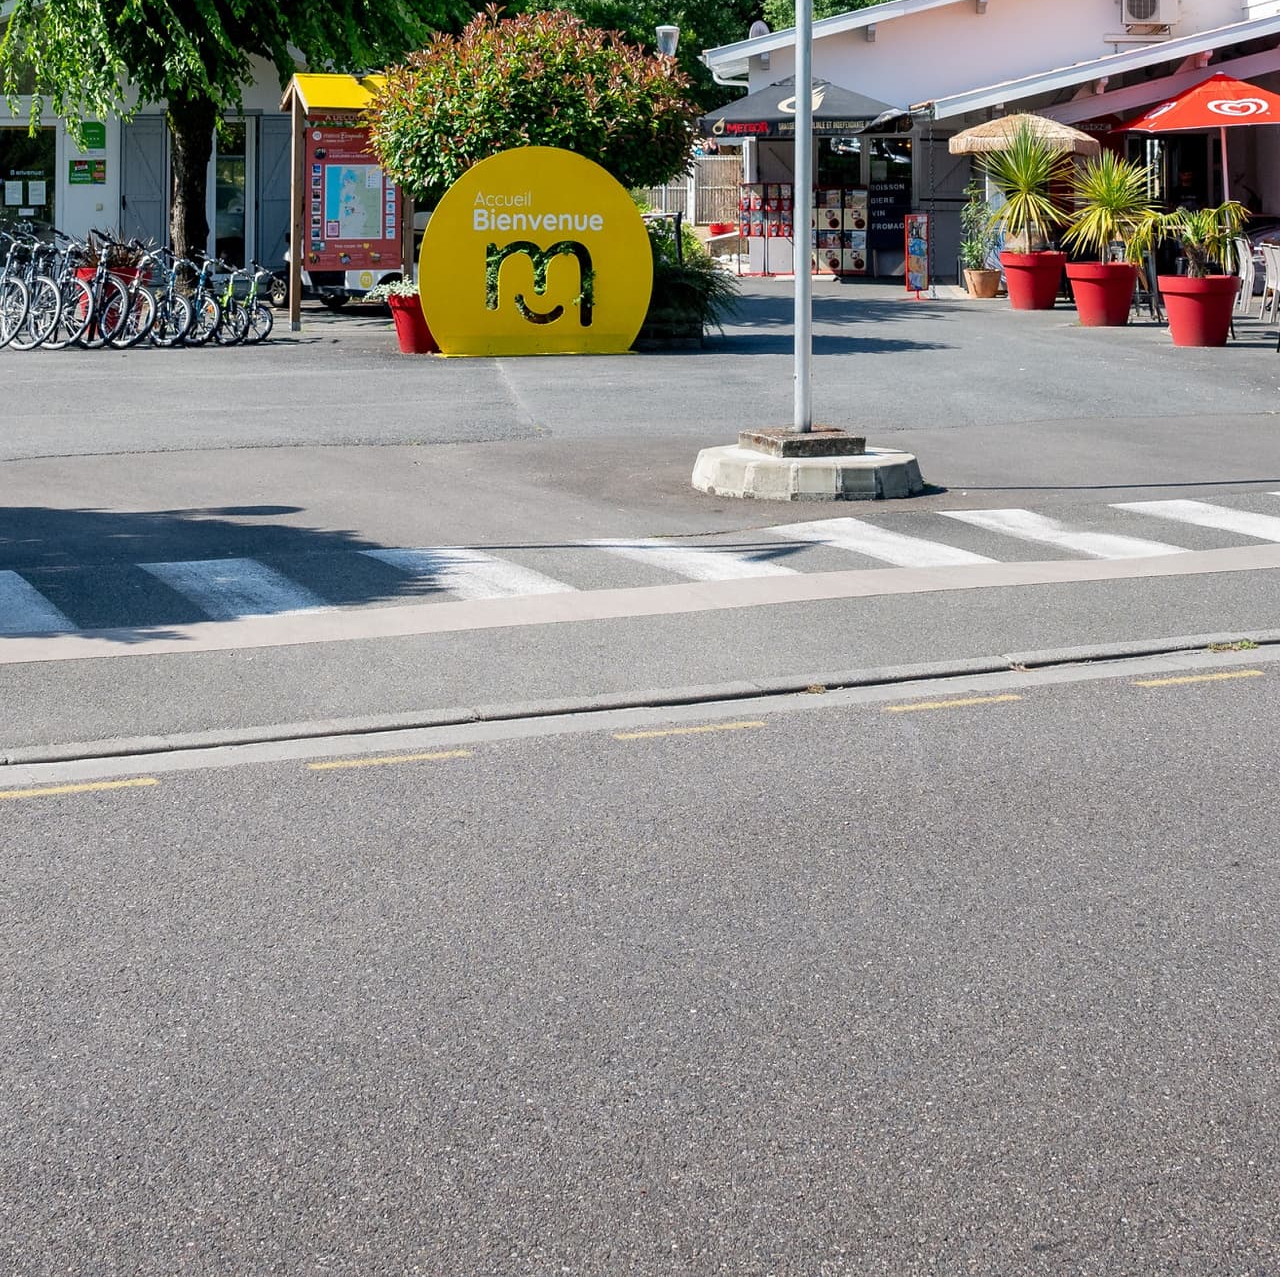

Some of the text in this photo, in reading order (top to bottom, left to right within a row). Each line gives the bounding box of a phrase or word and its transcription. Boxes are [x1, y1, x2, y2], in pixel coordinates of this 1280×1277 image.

[725, 121, 769, 133] METEOR
[473, 191, 532, 207] Accueil
[472, 208, 604, 232] Bienvenue
[871, 209, 886, 217] VIN
